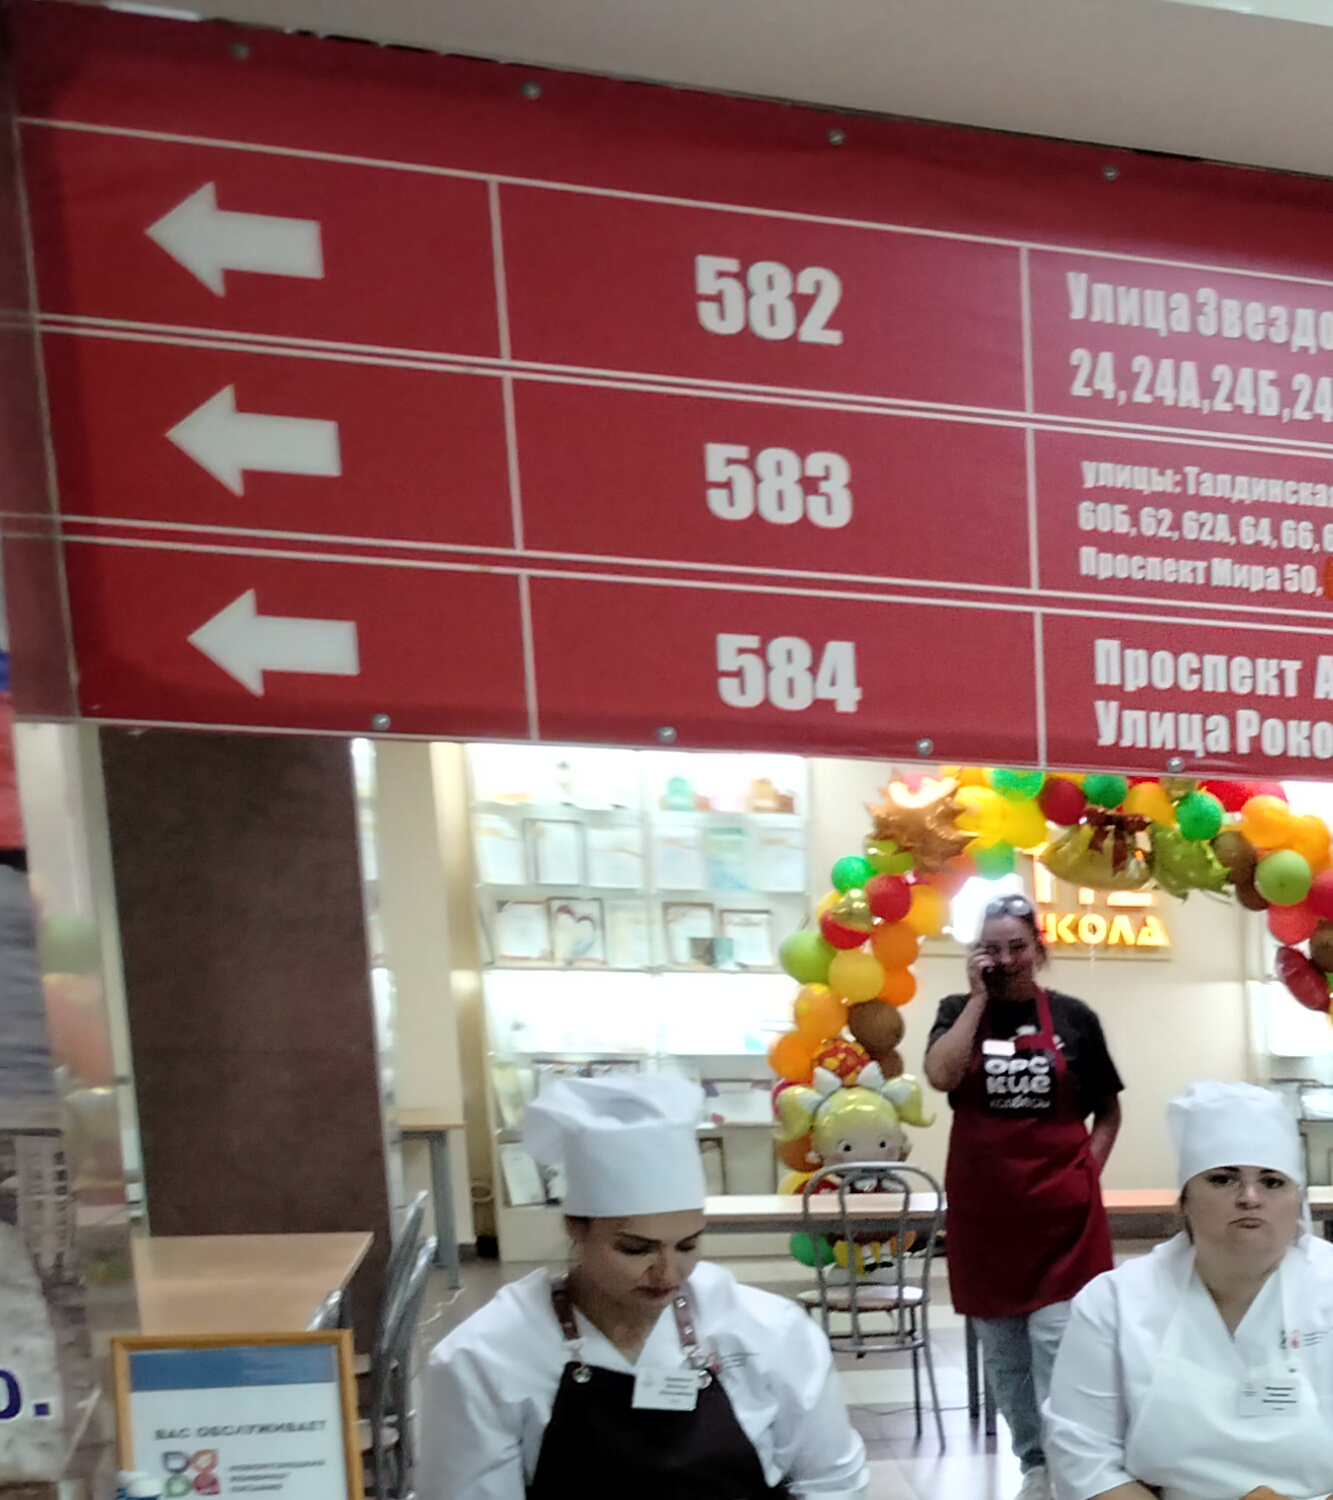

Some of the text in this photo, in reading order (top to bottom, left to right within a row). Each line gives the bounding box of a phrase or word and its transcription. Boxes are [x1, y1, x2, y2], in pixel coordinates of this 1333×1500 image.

[694, 254, 844, 346] 582
[704, 442, 853, 530] 583
[1079, 546, 1208, 584] Проспект
[1210, 557, 1282, 592] Мира
[715, 633, 863, 713] 584
[1094, 638, 1303, 698] Проспект
[1094, 700, 1231, 757] Улица
